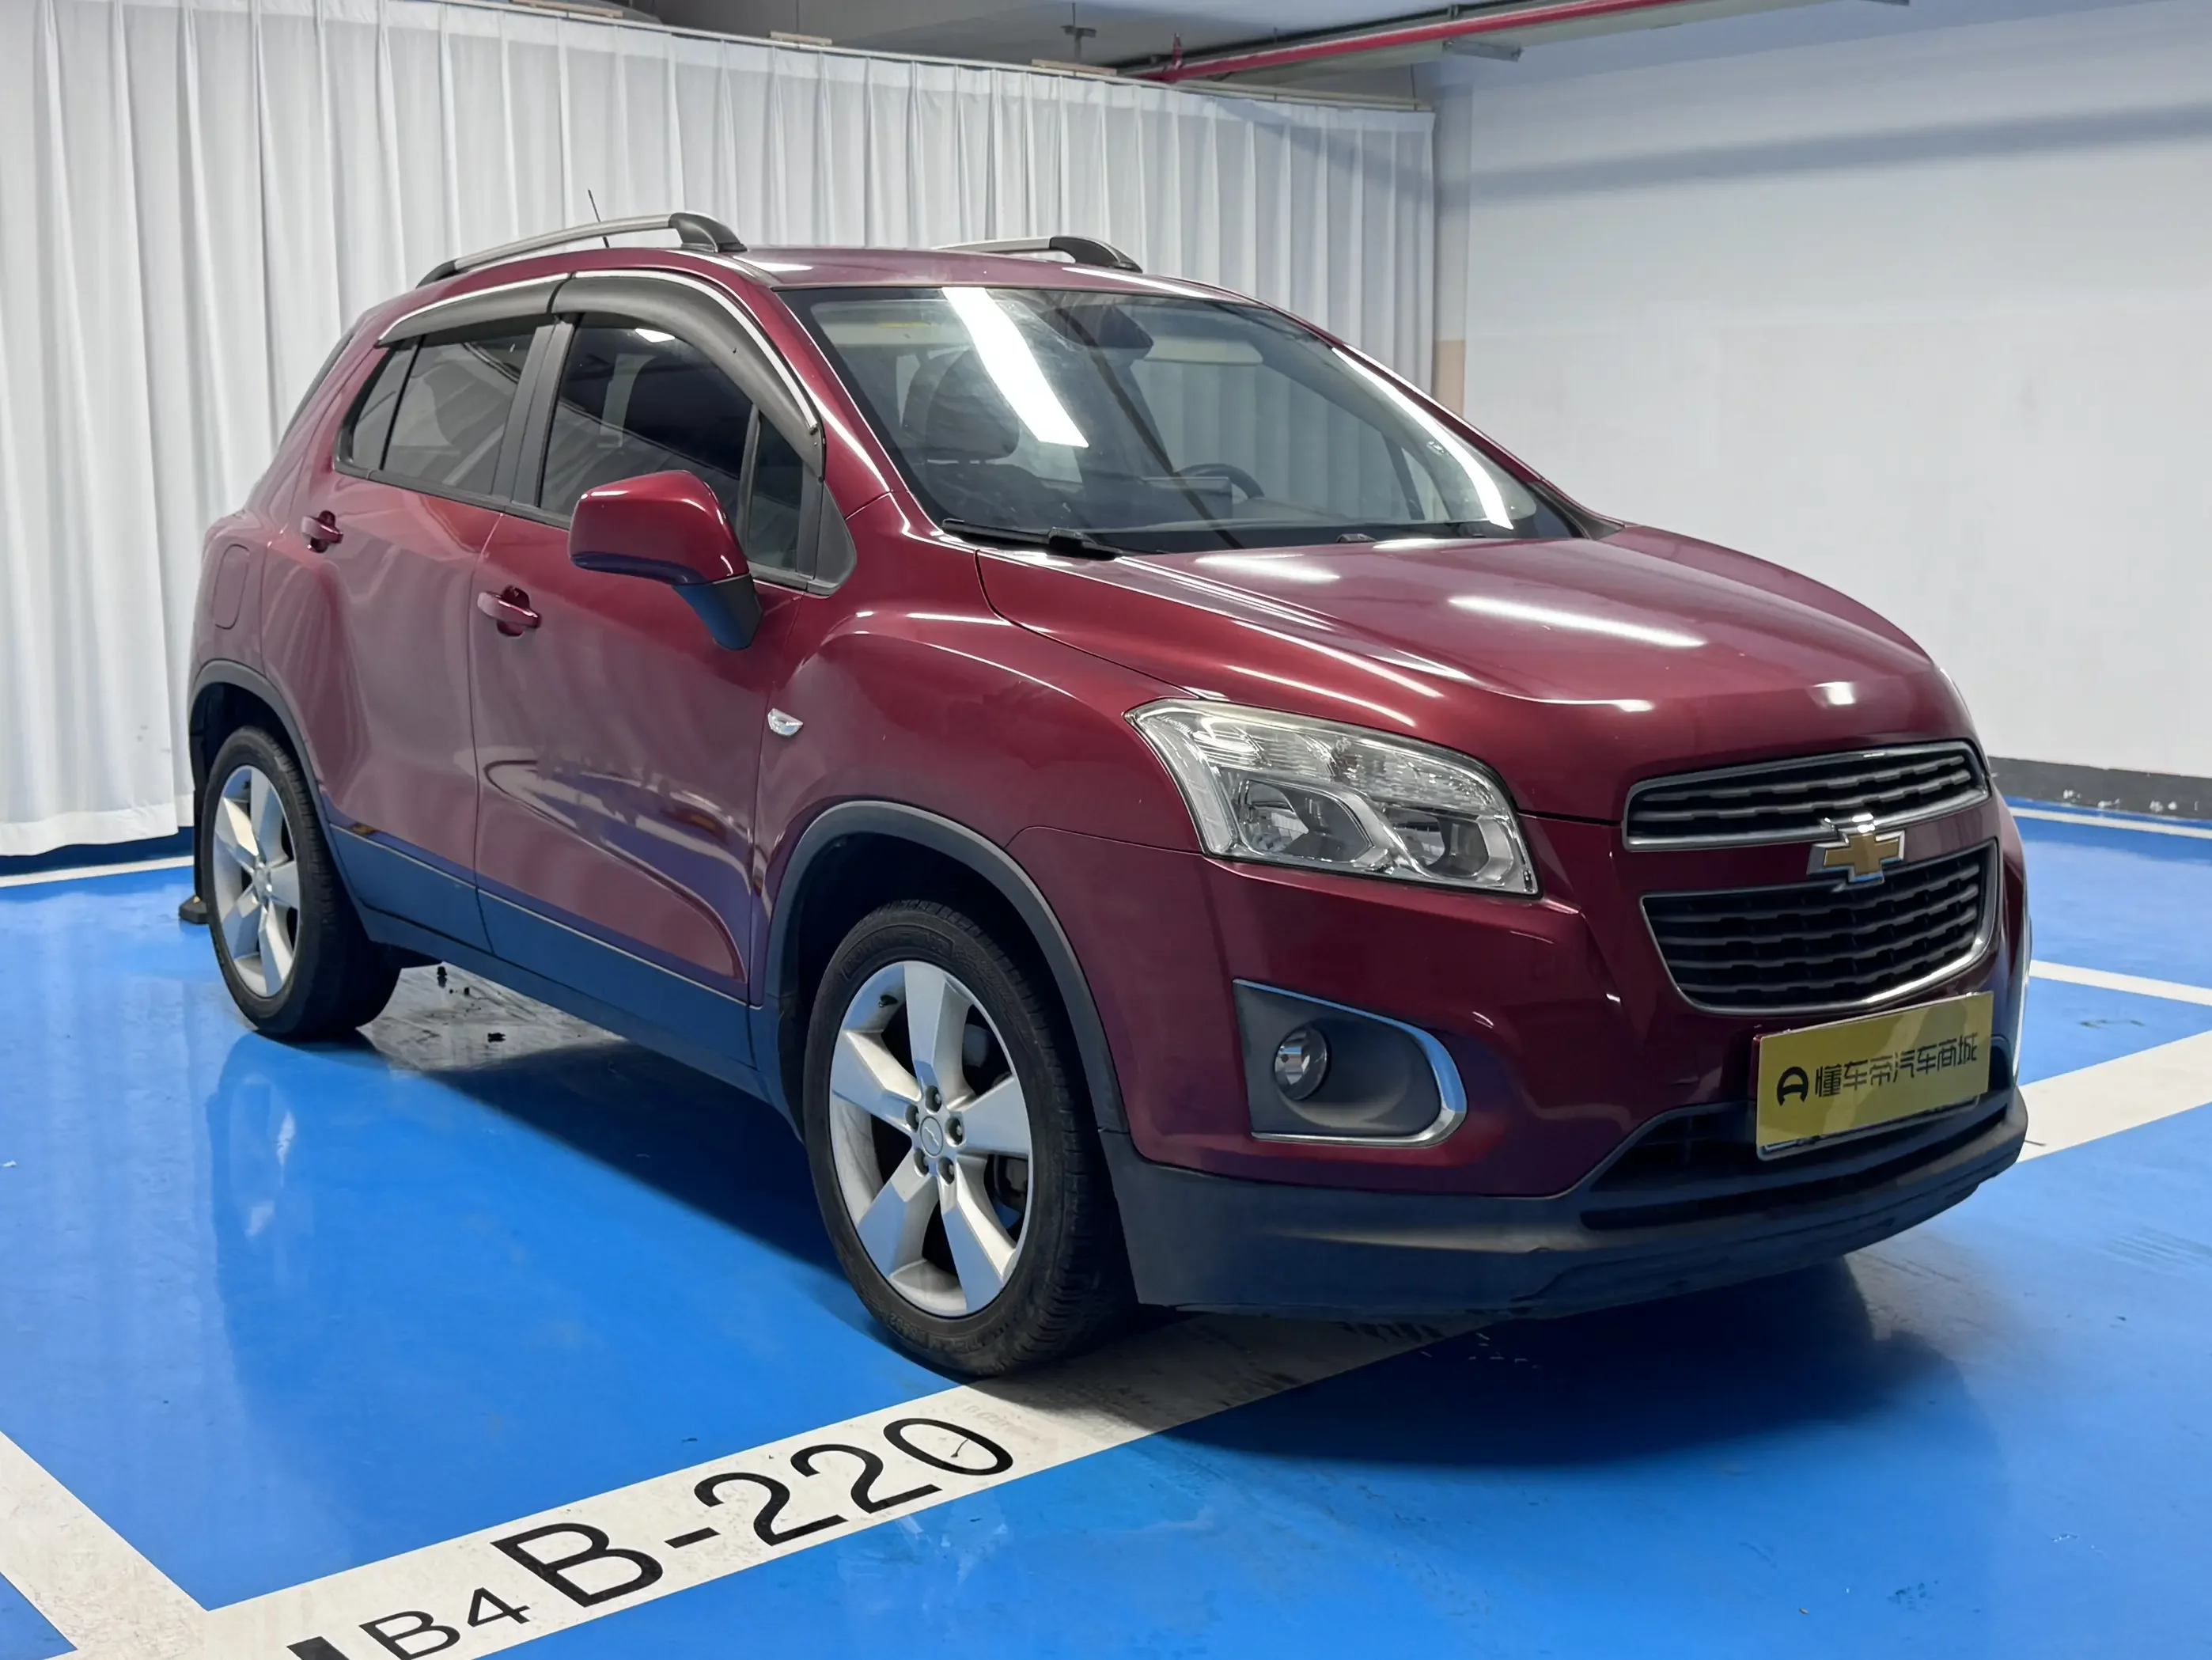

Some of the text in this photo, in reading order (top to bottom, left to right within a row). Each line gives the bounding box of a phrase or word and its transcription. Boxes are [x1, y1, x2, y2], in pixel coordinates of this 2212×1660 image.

[1815, 1033, 1979, 1097] 懂车帝汽车商城
[358, 1418, 1014, 1660] B4 B-220
